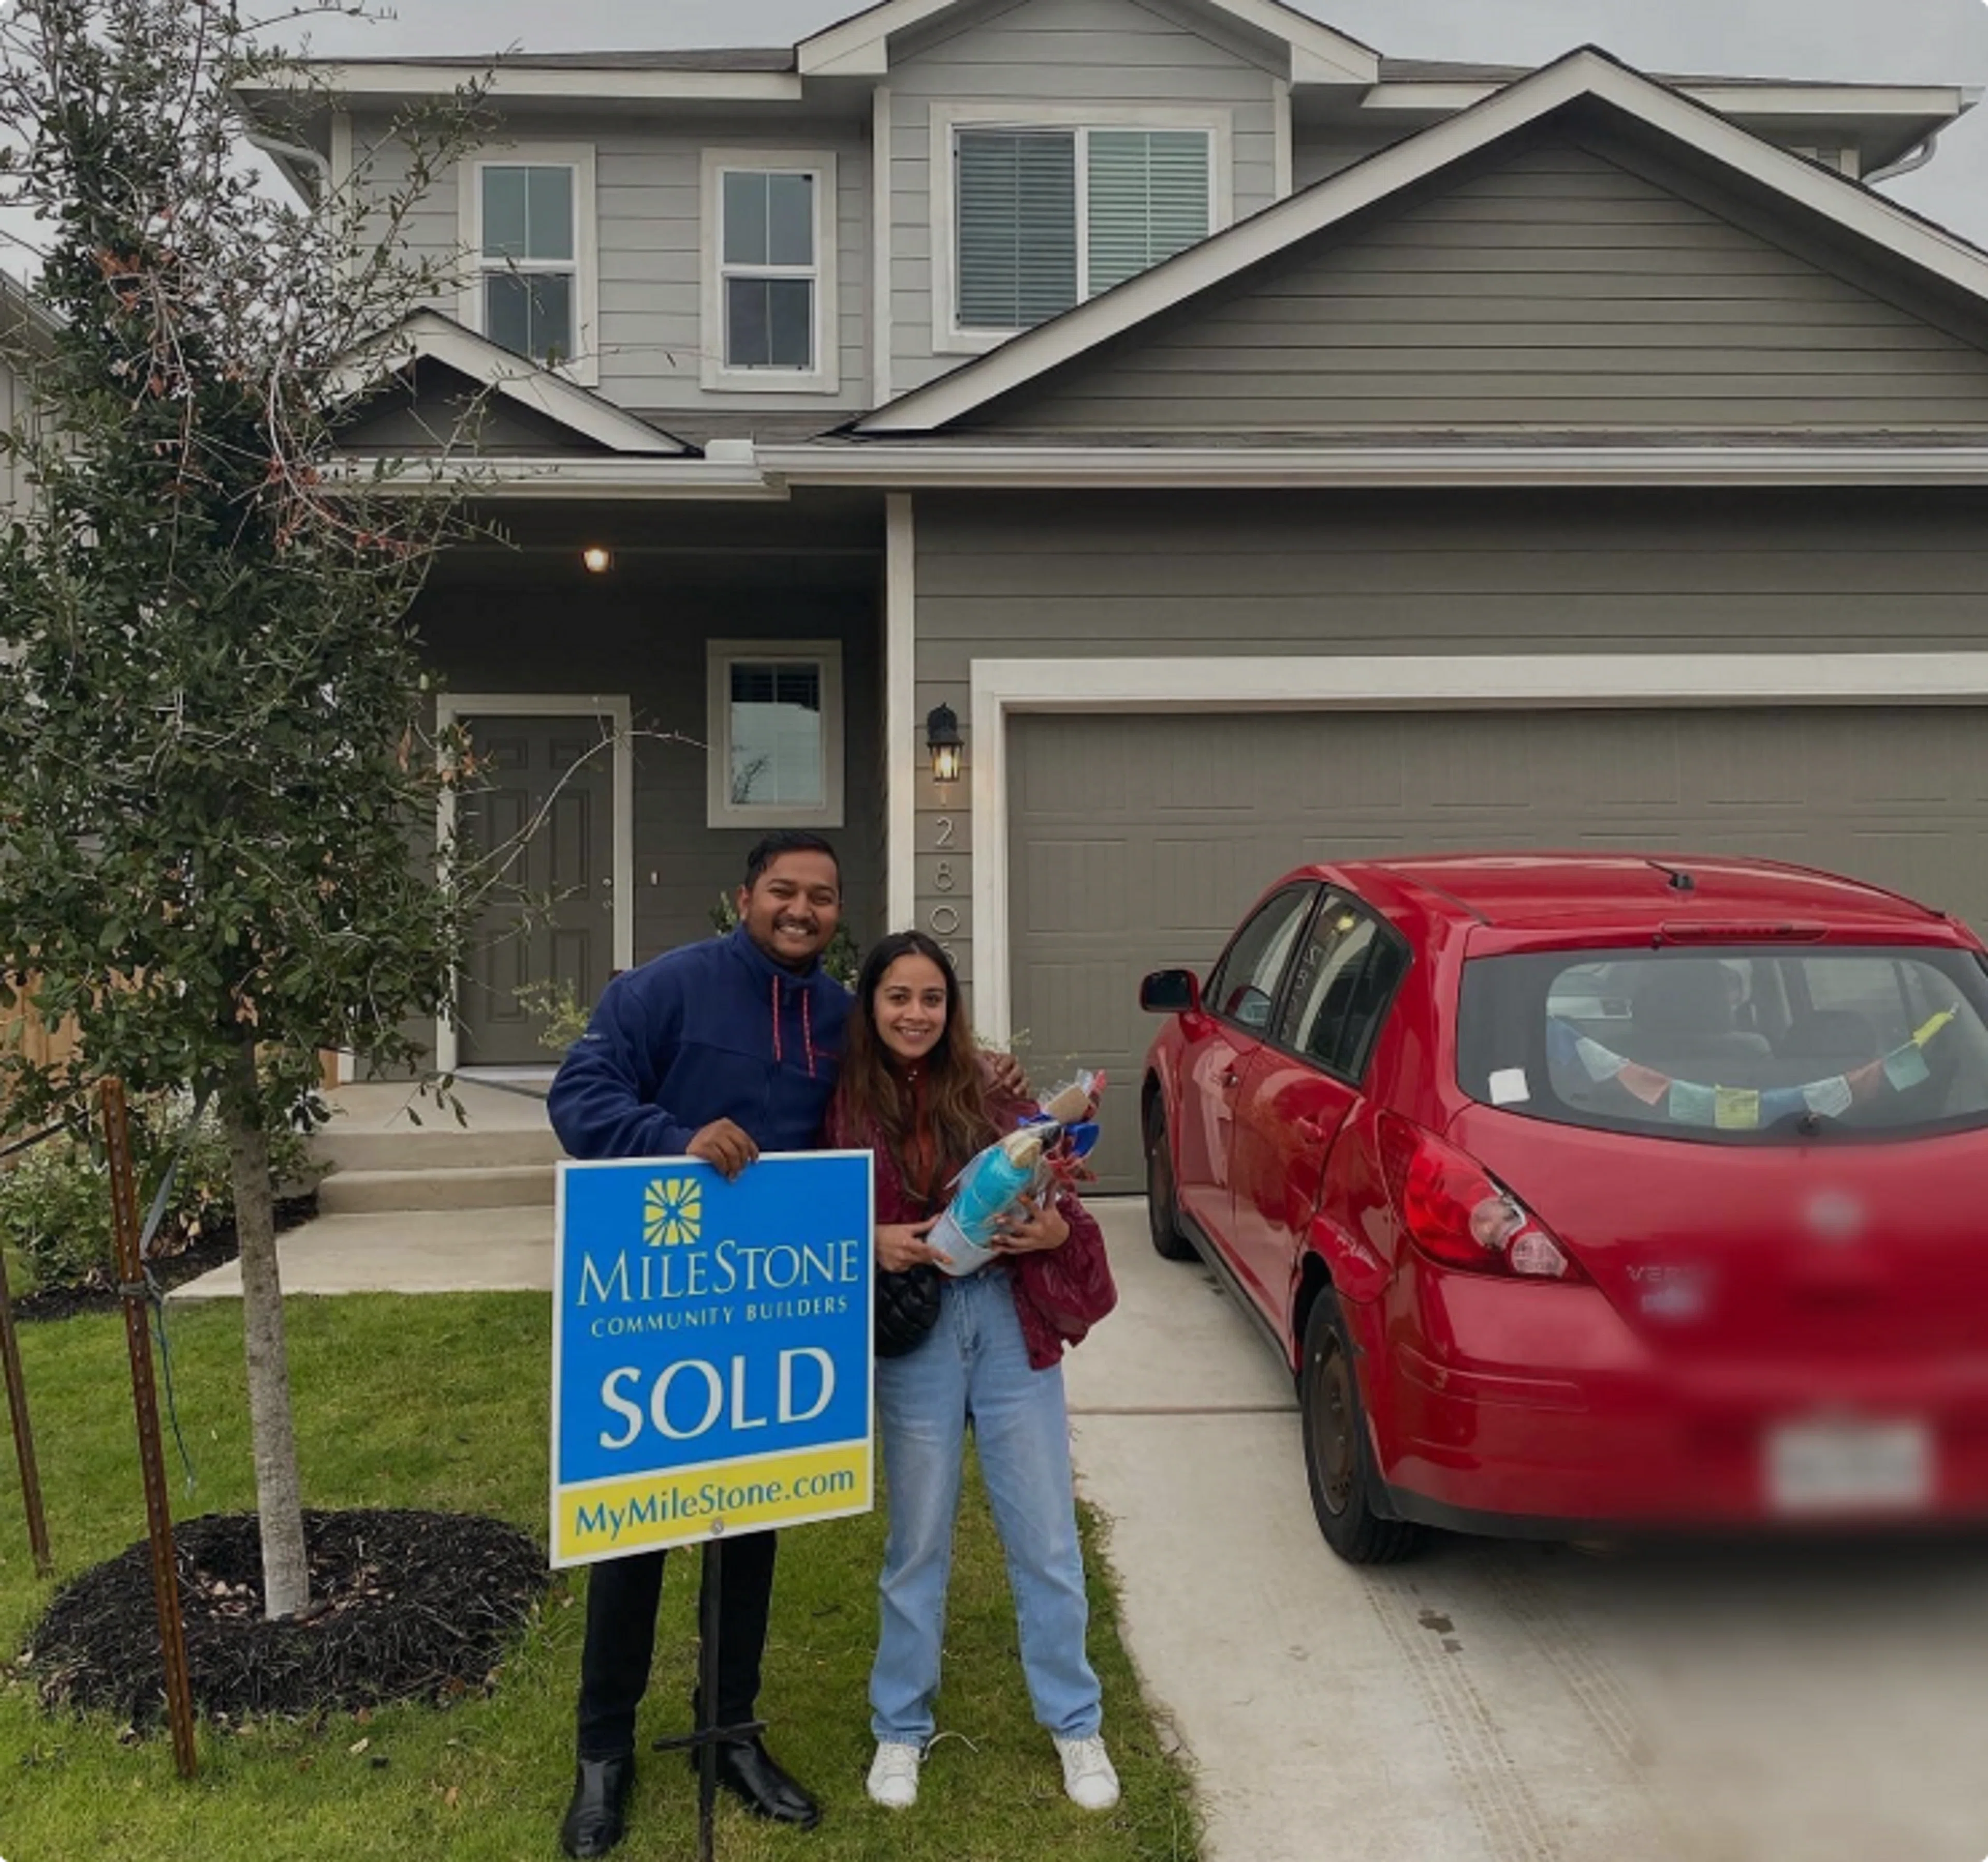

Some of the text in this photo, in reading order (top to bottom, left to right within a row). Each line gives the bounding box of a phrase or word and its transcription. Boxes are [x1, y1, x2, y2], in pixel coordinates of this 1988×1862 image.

[577, 1240, 858, 1306] MILESTONE
[591, 1296, 848, 1338] COMMUNITY BUILDERS
[600, 1347, 835, 1449] SOLD
[575, 1469, 854, 1540] MyMileStone.com
